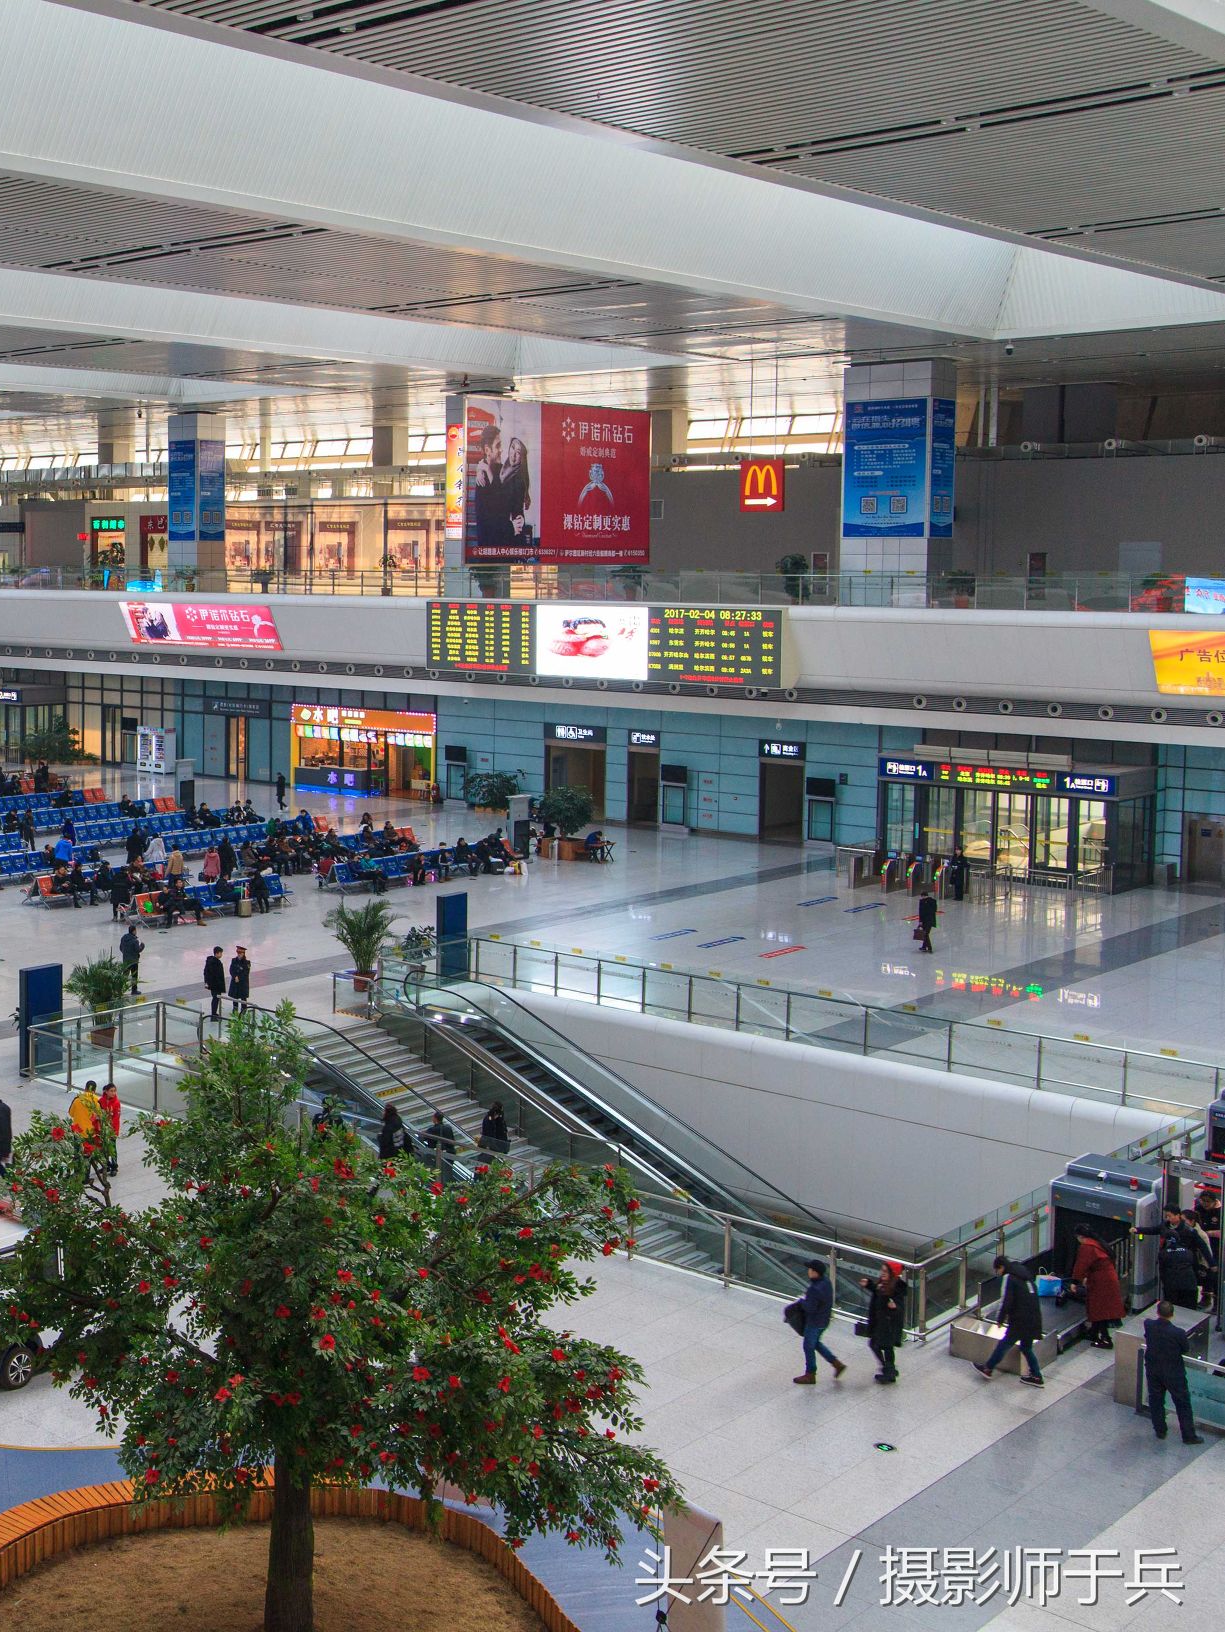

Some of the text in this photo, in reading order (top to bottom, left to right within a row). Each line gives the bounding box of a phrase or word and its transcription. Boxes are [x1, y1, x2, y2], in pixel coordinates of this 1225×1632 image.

[578, 421, 634, 444] 伊诺尔钻石
[563, 513, 631, 531] 裸钻定制更实惠
[199, 609, 250, 622] 伊诺尔钻石
[664, 609, 762, 620] 2017-02-04 08:27:33
[312, 708, 339, 724] 水吧
[577, 728, 594, 736] 卫生间
[917, 765, 928, 777] 1A
[1064, 776, 1076, 789] 1A
